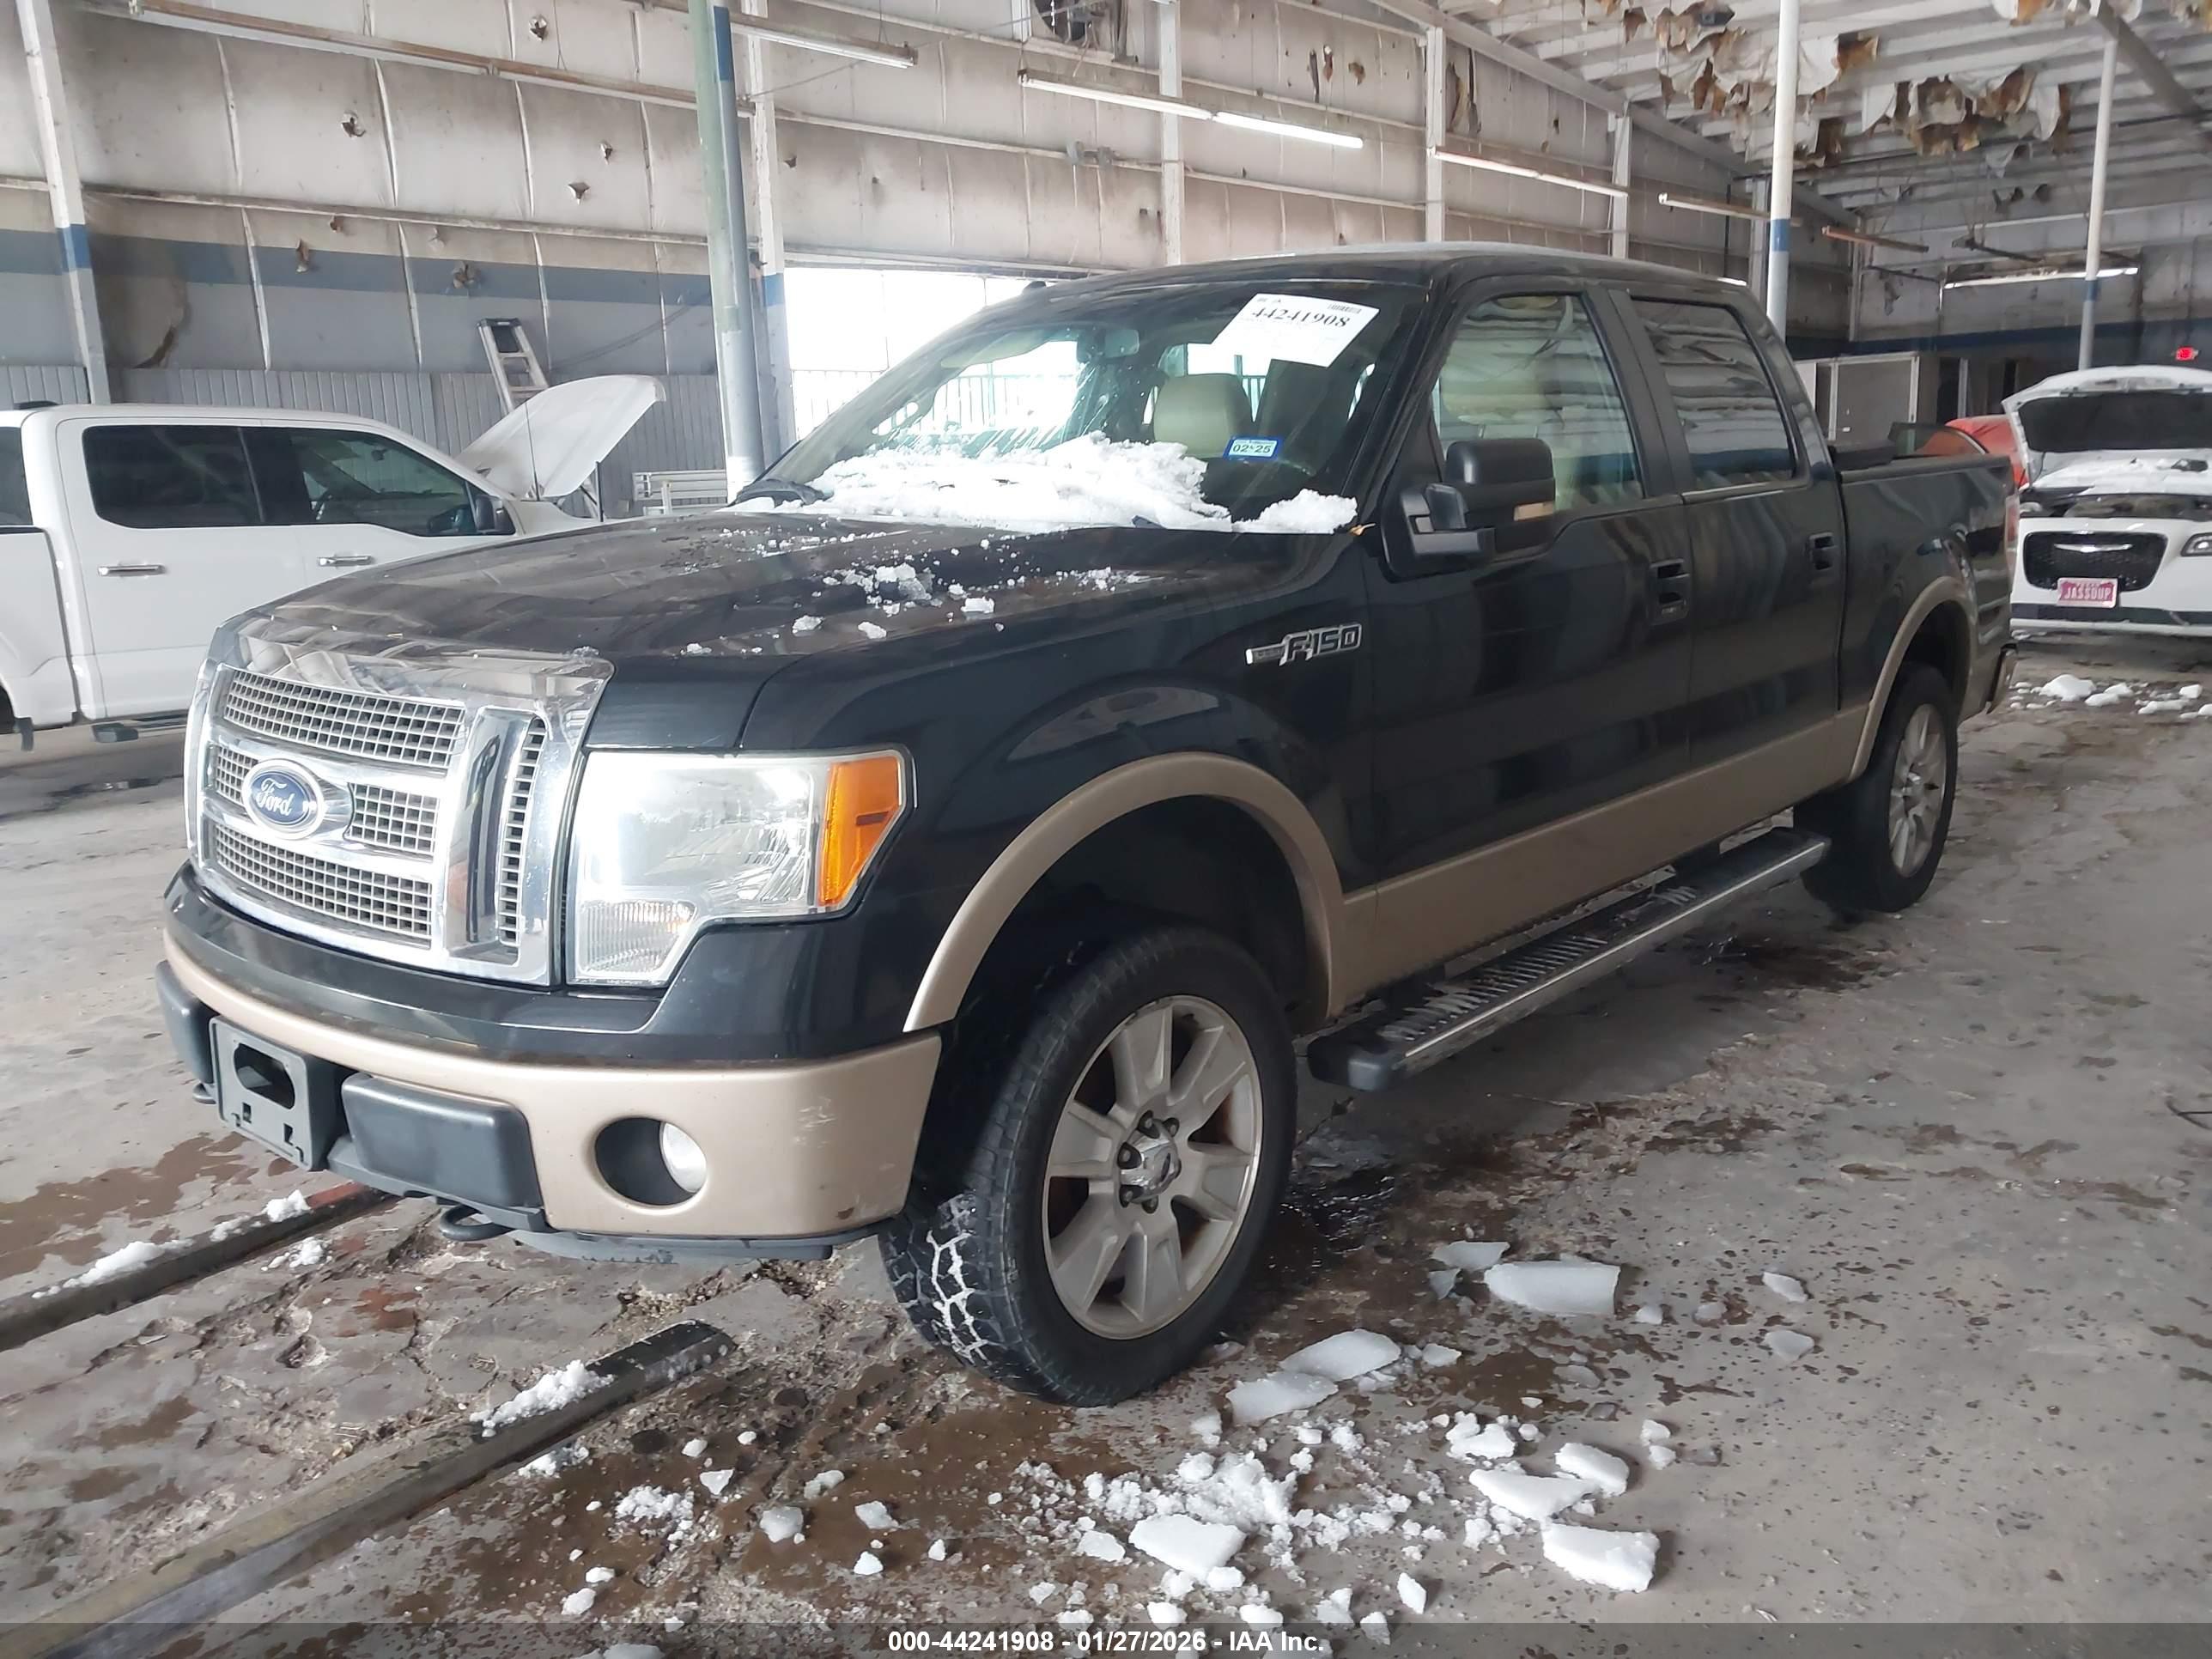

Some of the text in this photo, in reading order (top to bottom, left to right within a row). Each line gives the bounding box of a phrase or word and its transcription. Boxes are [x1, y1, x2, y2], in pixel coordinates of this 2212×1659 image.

[1252, 307, 1351, 328] 44241908
[1233, 444, 1272, 453] 02 25
[255, 777, 296, 817] Ford
